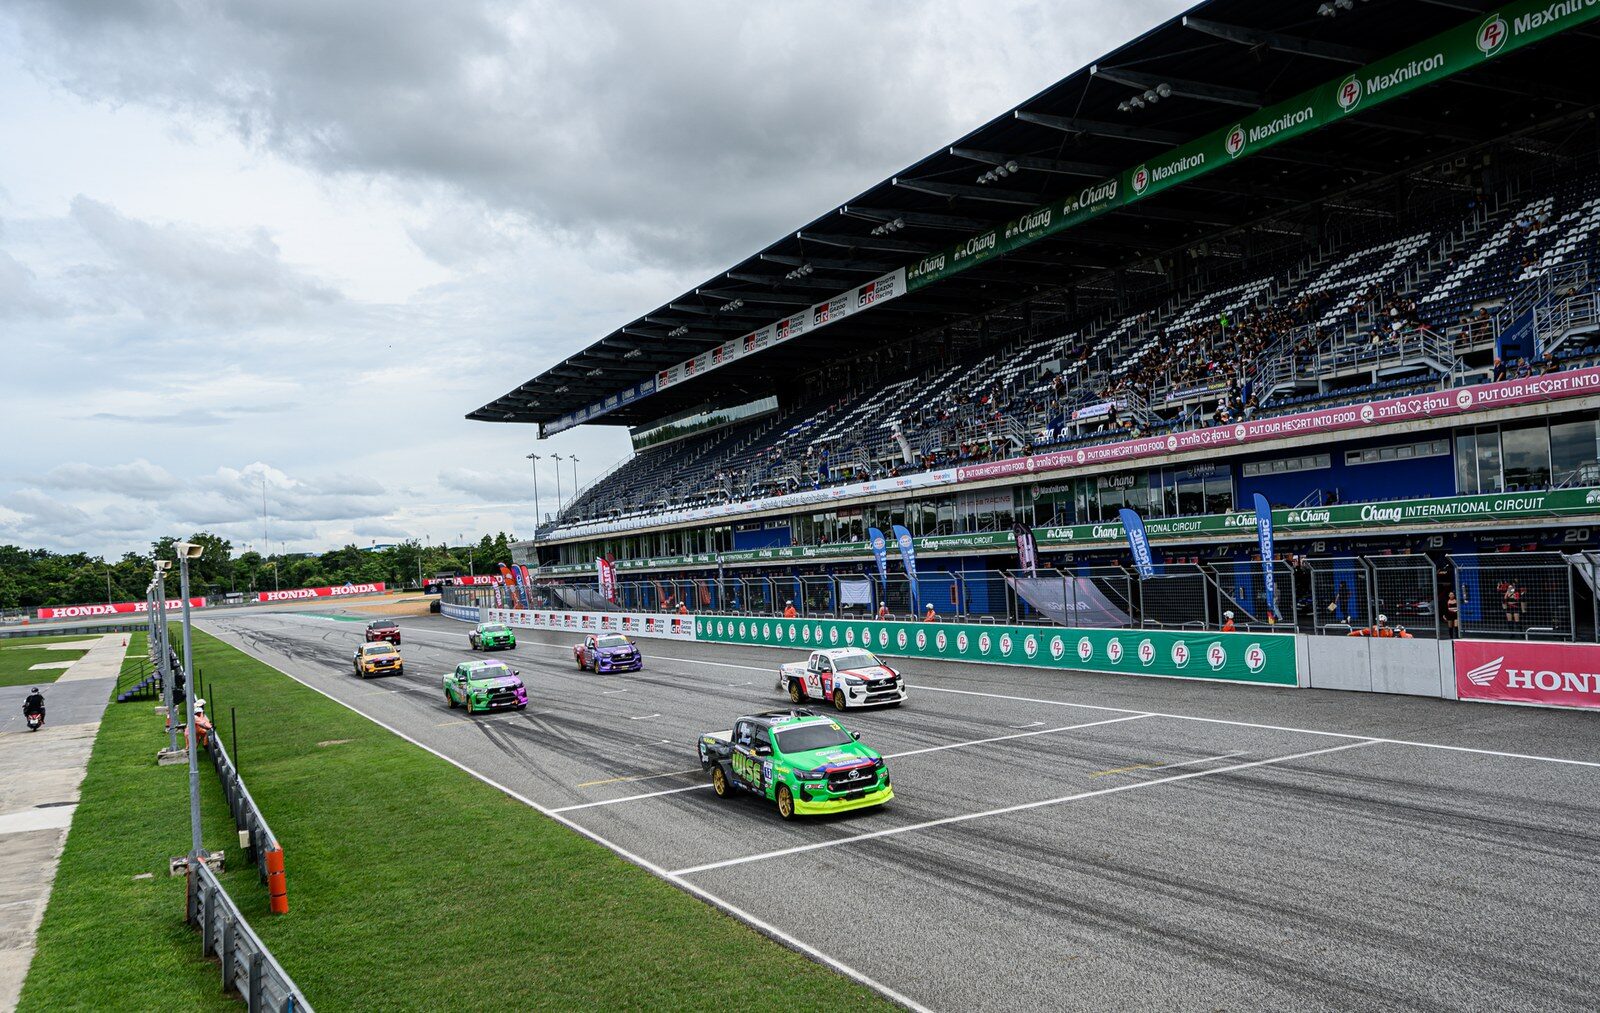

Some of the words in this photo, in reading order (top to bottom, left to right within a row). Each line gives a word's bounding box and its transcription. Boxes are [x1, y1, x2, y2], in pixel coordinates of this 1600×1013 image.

[1484, 24, 1501, 46] PT
[1343, 83, 1357, 103] PT
[1366, 53, 1444, 95] Maxnitron
[1230, 132, 1242, 151] PT
[1249, 107, 1314, 143] Maxnitron
[1152, 152, 1205, 182] Maxnitron
[1079, 180, 1118, 209] Chang
[1018, 209, 1051, 233] Chang
[966, 232, 996, 255] Chang
[919, 254, 945, 275] Chang
[876, 275, 896, 288] TOYOTA
[874, 289, 893, 301] Racing
[875, 283, 893, 295] GAZOO
[1478, 389, 1499, 402] PUT
[1500, 386, 1523, 398] OUR
[1571, 374, 1599, 387] INTO
[1249, 425, 1265, 435] PUT
[1265, 422, 1281, 433] OUR
[1312, 415, 1332, 426] INTO
[1333, 411, 1356, 423] FOOD
[1087, 450, 1099, 459] PUT
[1099, 448, 1111, 457] OUR
[1133, 443, 1148, 452] INTO
[1148, 440, 1164, 450] FOOD
[966, 469, 975, 477] PUT
[1012, 462, 1025, 470] FOOD
[1108, 474, 1134, 487] Chang
[1301, 510, 1330, 523] Chang
[1361, 505, 1402, 522] Chang
[1405, 501, 1491, 516] INTERNATIONAL
[1494, 497, 1545, 511] CIRCUIT
[1236, 514, 1258, 526] Chan
[1055, 528, 1073, 539] Chang
[1092, 525, 1118, 539] Chang
[1172, 521, 1202, 532] CIRCUIT
[1564, 528, 1589, 542] 20
[921, 538, 938, 550] Chang
[975, 536, 993, 544] CIRCUIT
[1311, 541, 1326, 552] 18
[1427, 536, 1443, 548] 19
[1217, 546, 1229, 556] 17
[267, 589, 318, 601] HONDA
[331, 583, 377, 595] HONDA
[52, 605, 118, 618] HONDA
[1053, 641, 1062, 655] PT
[1081, 643, 1089, 657] PT
[1111, 644, 1119, 658] PT
[1142, 645, 1151, 660] PT
[1176, 647, 1185, 662] PT
[1212, 649, 1222, 664] PT
[1250, 650, 1261, 667] PT
